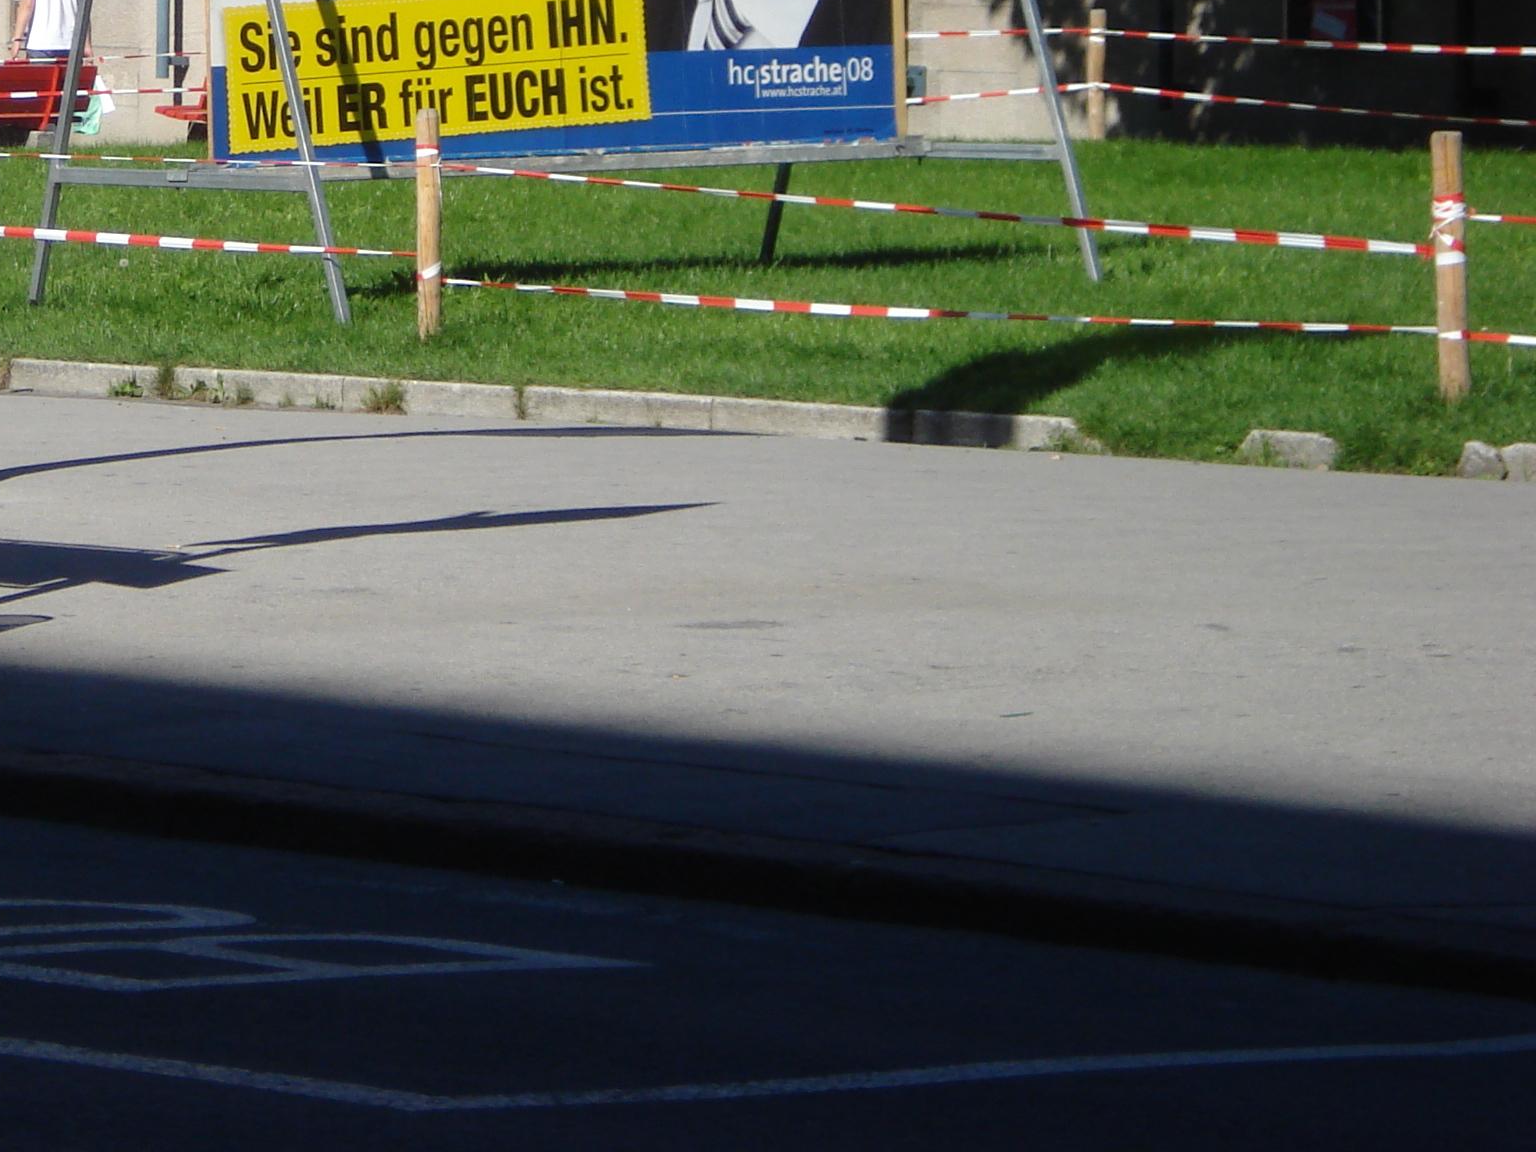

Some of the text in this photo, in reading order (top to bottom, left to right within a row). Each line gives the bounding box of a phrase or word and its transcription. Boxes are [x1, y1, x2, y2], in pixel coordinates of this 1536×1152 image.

[240, 20, 301, 73] Sie
[315, 12, 400, 67] sind
[413, 11, 534, 71] gegen
[242, 63, 634, 141] Weil ER für EUCH ist.
[761, 85, 843, 98] www.hcstrache.at
